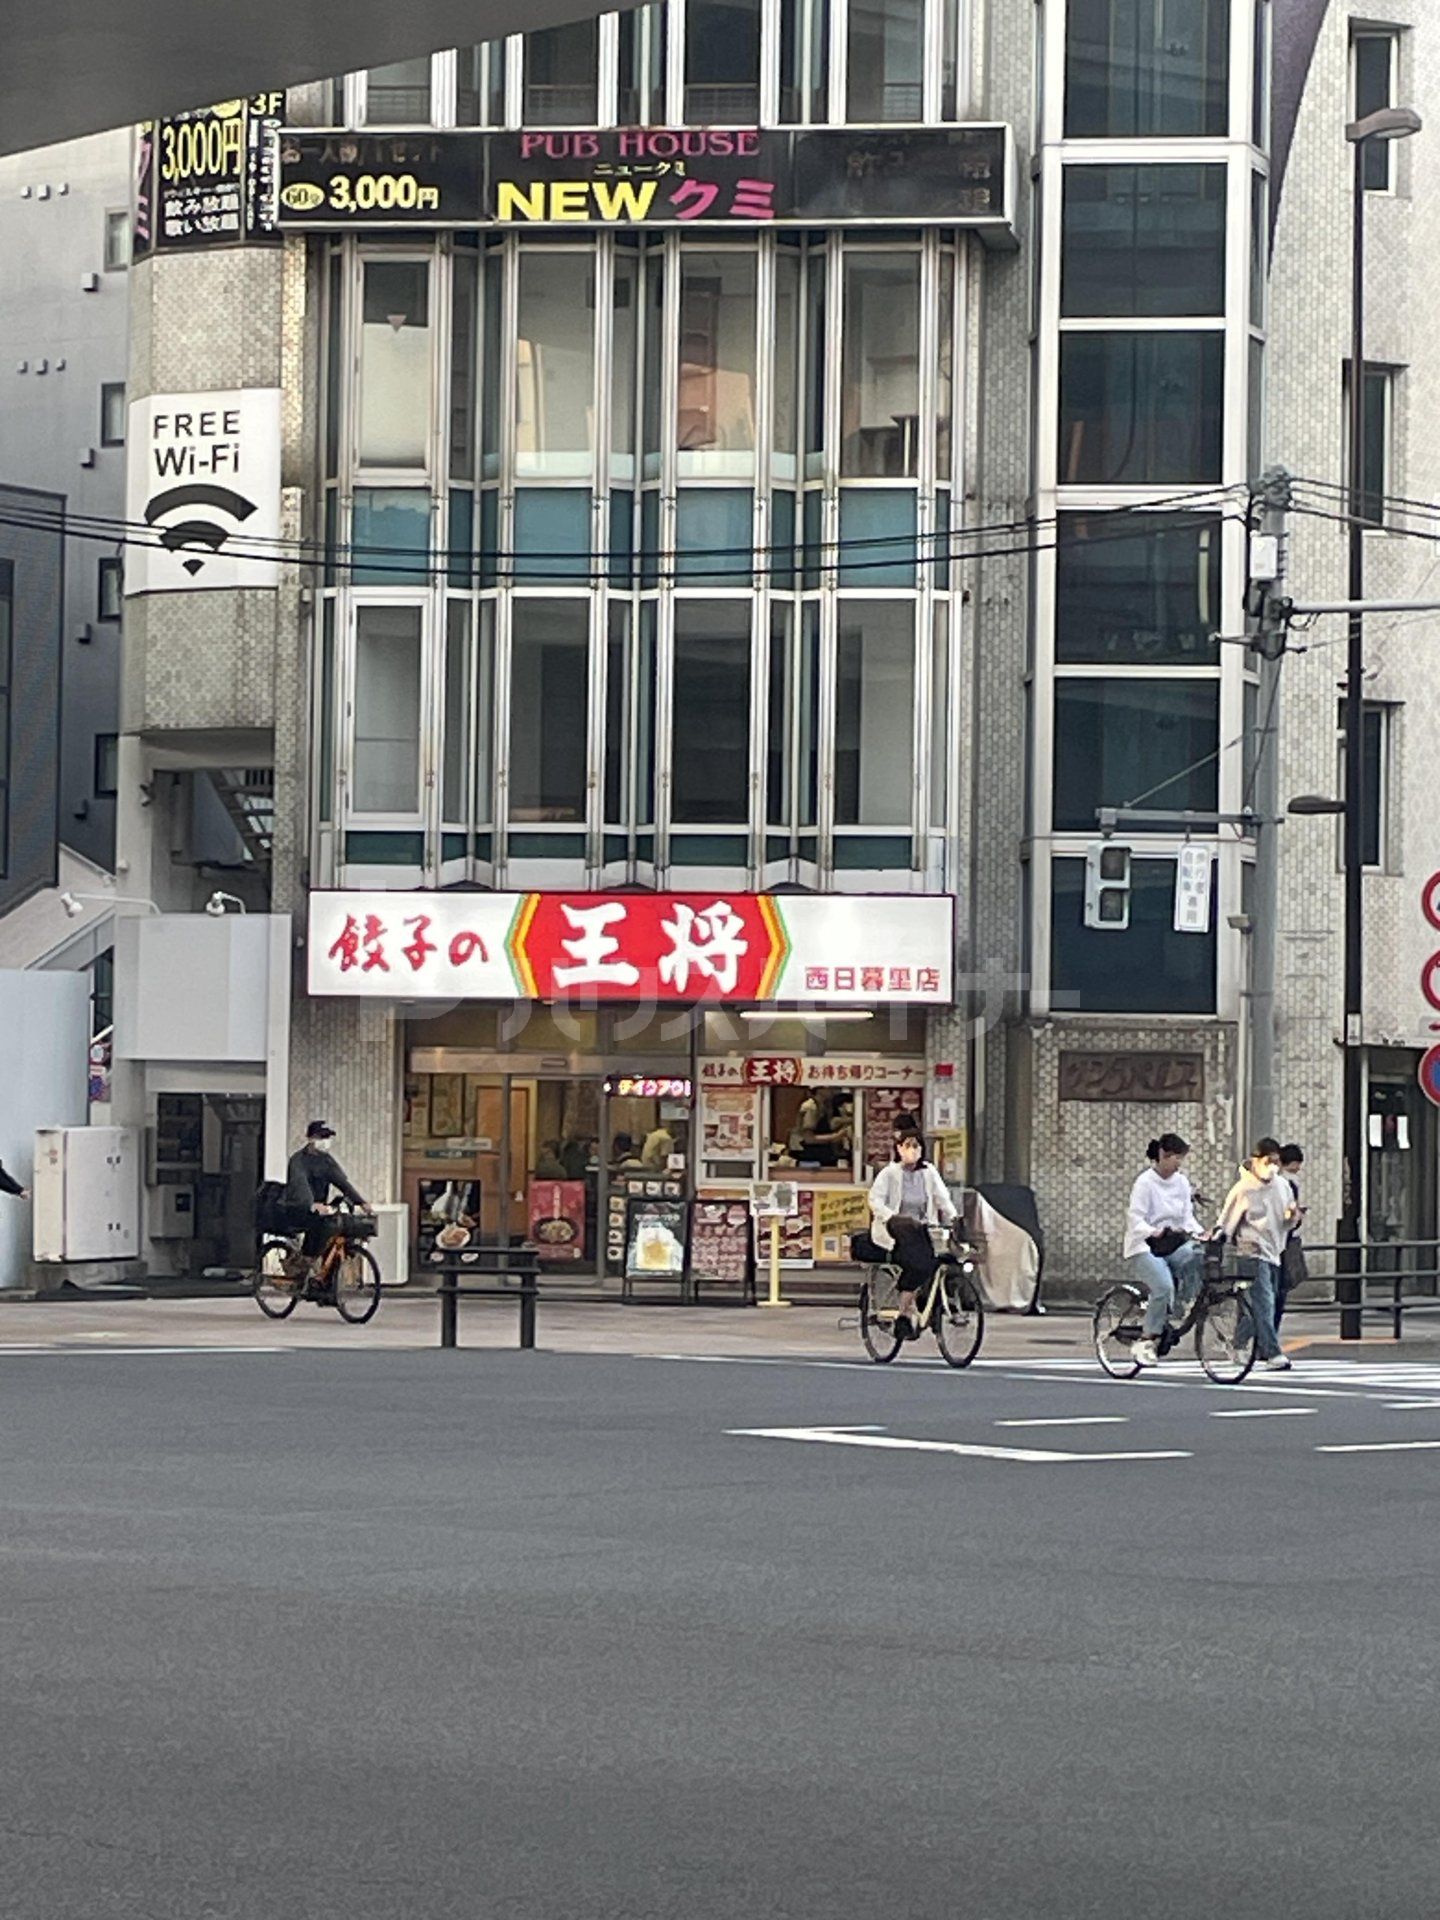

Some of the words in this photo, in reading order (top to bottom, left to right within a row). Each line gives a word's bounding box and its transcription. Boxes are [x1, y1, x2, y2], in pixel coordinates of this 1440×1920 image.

[249, 92, 284, 116] 3F
[162, 117, 242, 187] 3,000円
[520, 132, 600, 159] PUB
[618, 131, 761, 157] HOUSE
[593, 161, 687, 177] ニュークミ
[329, 174, 440, 214] 3,000円
[497, 182, 658, 221] NEW
[669, 179, 776, 220] クミ
[153, 410, 240, 439] FREE
[154, 442, 240, 477] Wi-Fi
[328, 914, 490, 973] 餃子の
[551, 900, 750, 995] 王将
[804, 966, 942, 992] 西日暮里店
[750, 1059, 797, 1085] 王将
